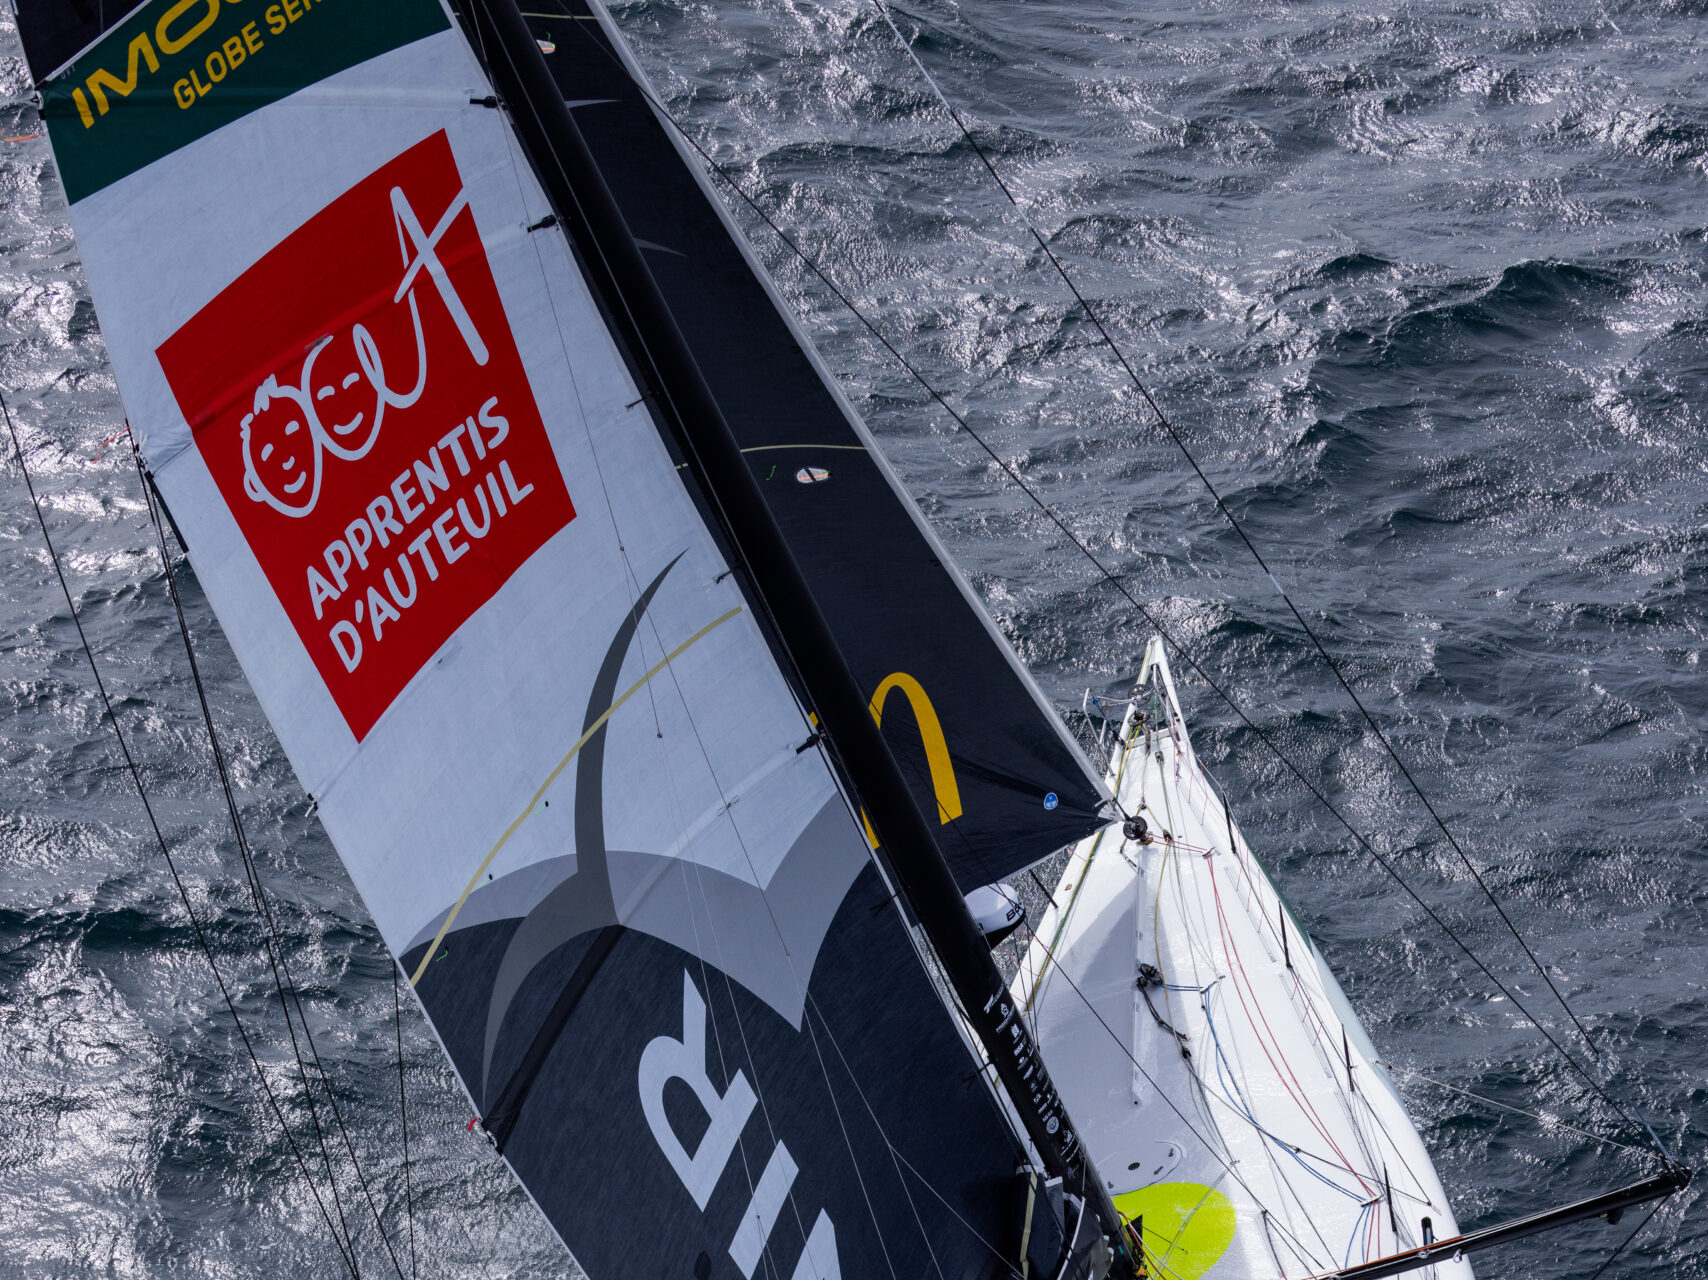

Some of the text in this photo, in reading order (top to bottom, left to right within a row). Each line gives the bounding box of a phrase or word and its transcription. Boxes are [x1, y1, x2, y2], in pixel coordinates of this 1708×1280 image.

[71, 0, 246, 129] IMO
[173, 0, 323, 110] GLOBE SE
[306, 396, 510, 620] APPRENTIS
[328, 460, 535, 674] D'AUTEUIL
